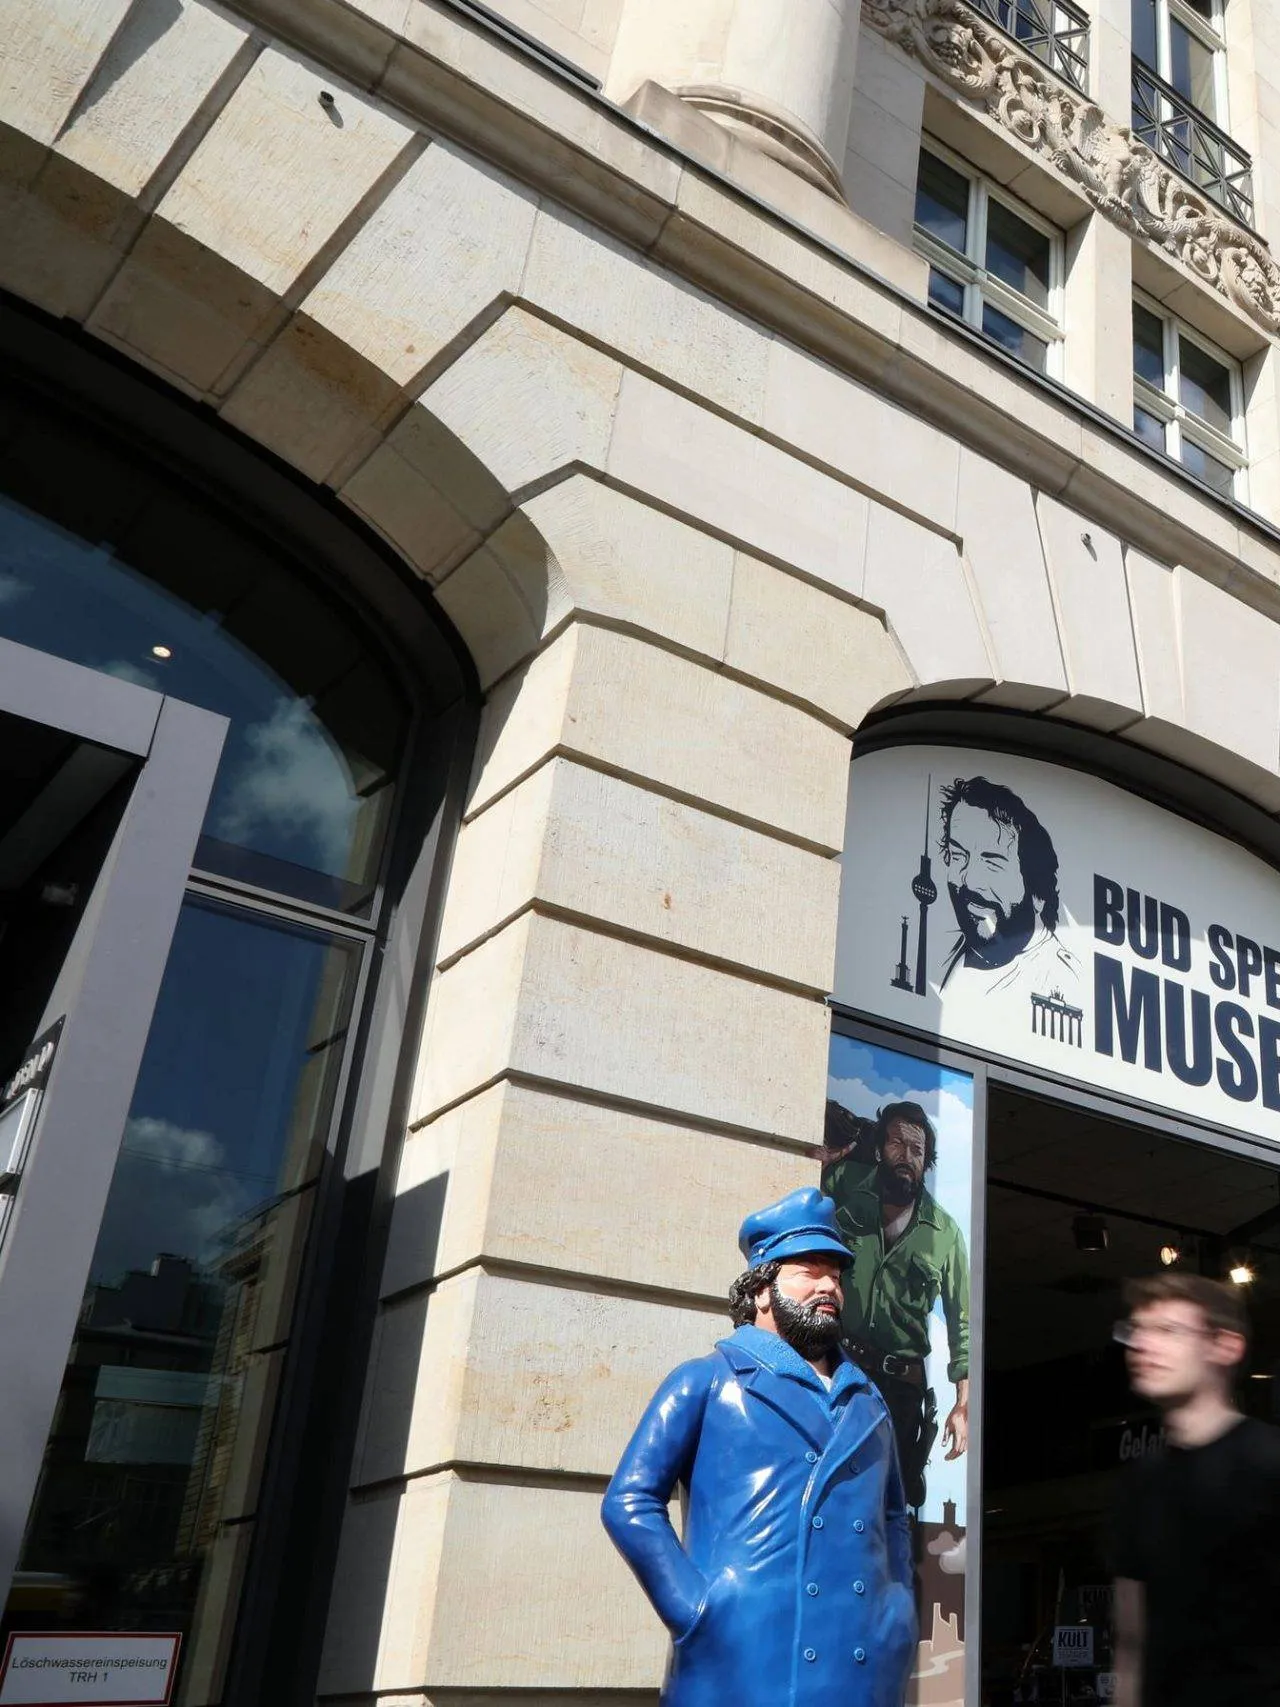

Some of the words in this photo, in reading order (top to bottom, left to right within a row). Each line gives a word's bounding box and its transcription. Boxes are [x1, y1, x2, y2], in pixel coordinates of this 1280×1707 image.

[1093, 872, 1191, 973] BUD
[1057, 1631, 1089, 1648] KULT
[12, 1656, 168, 1670] Löschwassereinspeisung
[69, 1671, 98, 1683] TRH
[102, 1672, 109, 1682] 1
